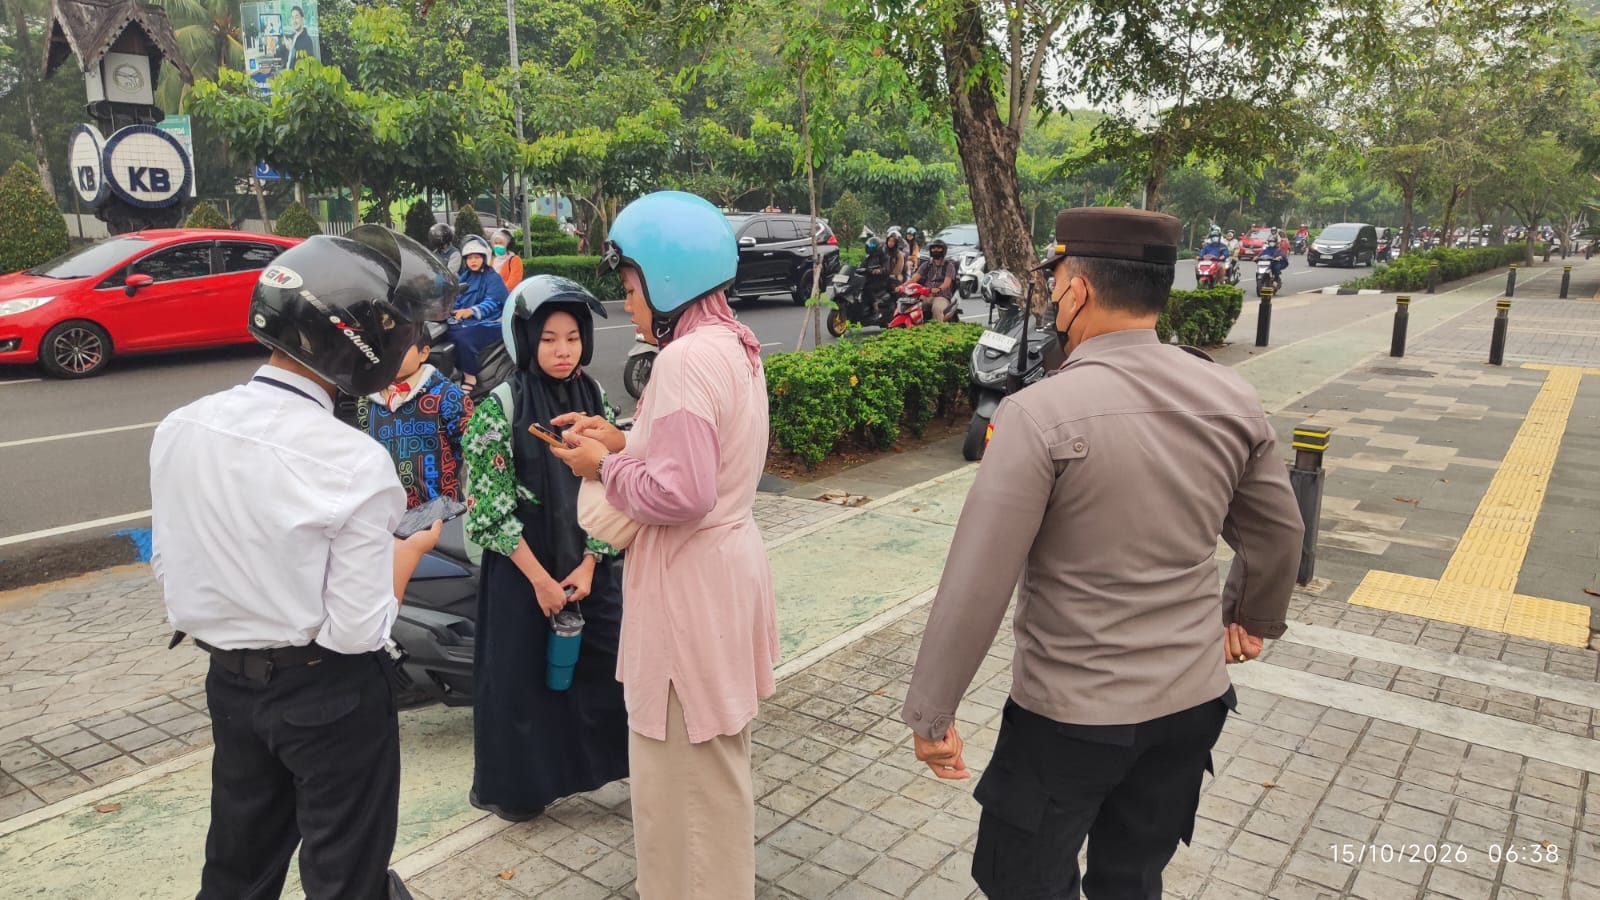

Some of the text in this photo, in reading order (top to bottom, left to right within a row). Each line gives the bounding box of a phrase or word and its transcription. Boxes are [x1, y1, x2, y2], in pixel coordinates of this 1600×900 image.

[78, 166, 96, 192] KB
[129, 166, 171, 192] KB
[266, 269, 292, 284] GM
